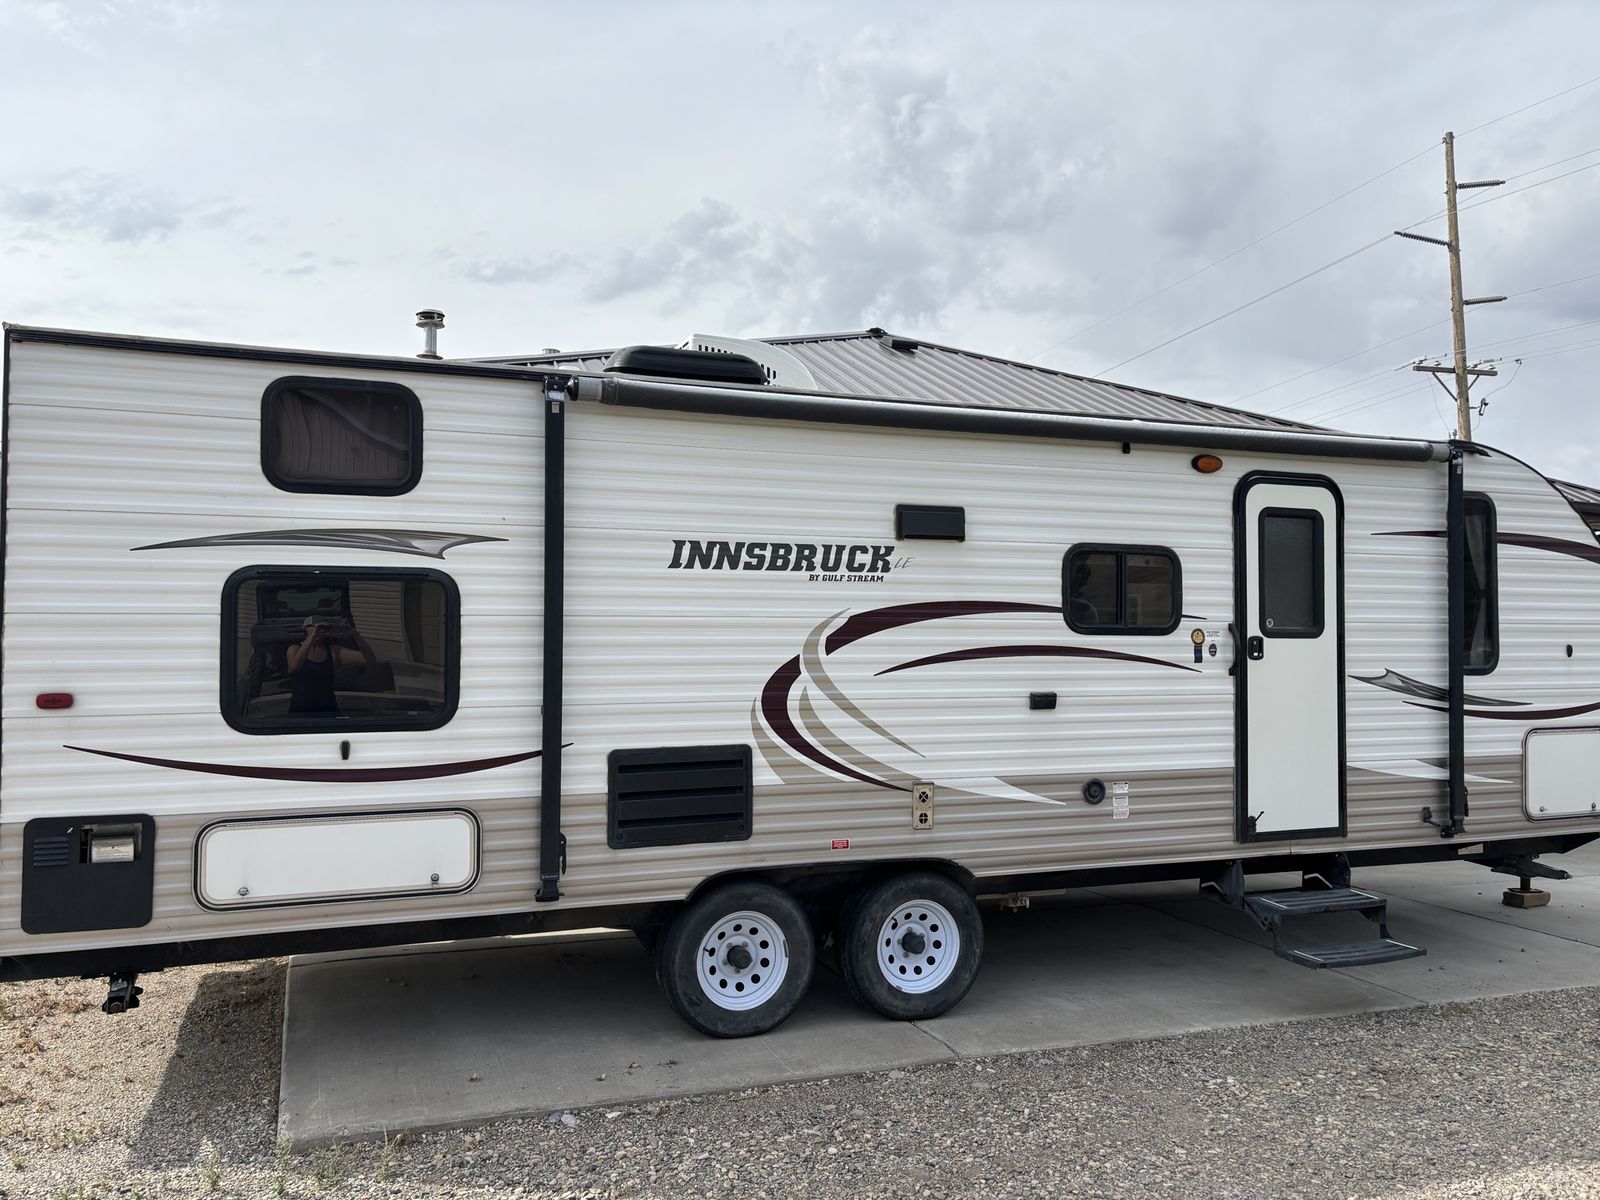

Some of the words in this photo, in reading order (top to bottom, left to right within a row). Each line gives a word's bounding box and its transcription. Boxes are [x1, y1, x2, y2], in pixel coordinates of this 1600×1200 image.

[668, 539, 895, 573] INNSBRUCK
[808, 573, 819, 582] BY
[822, 574, 846, 582] GULF
[847, 574, 884, 582] STREAM
